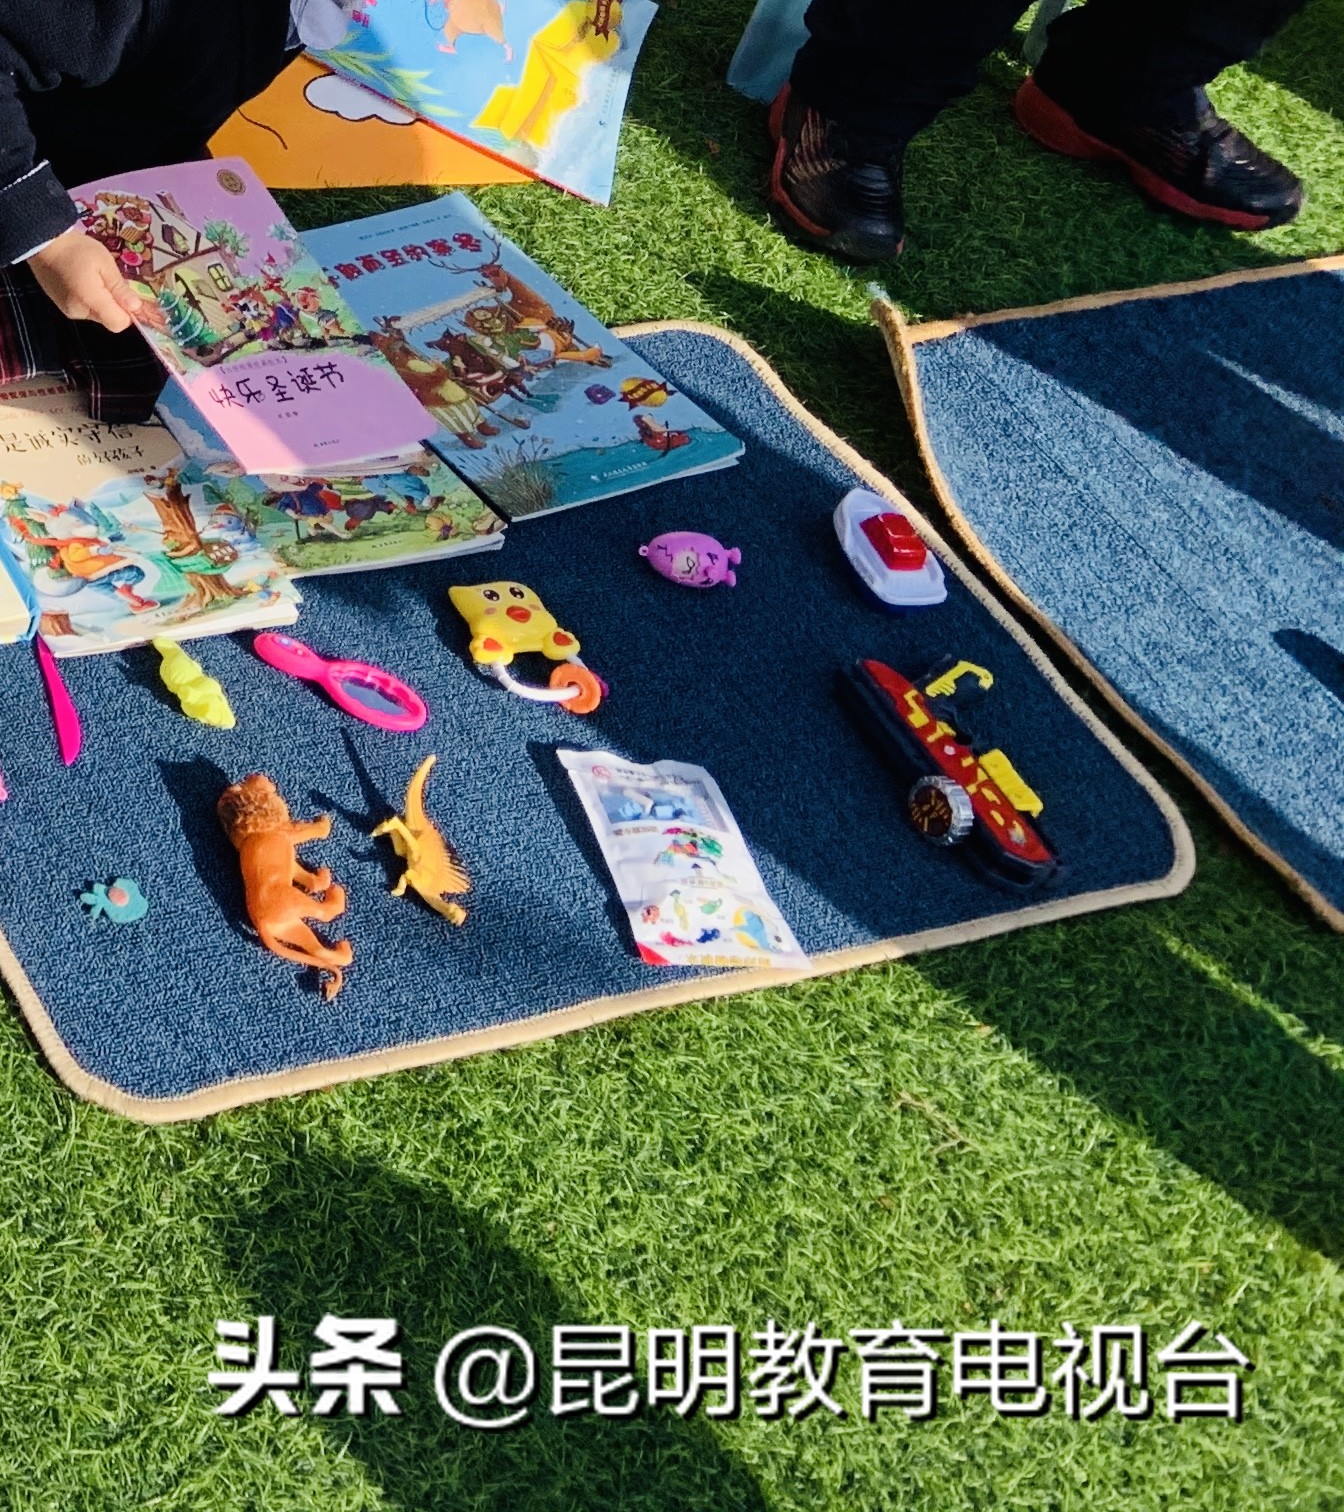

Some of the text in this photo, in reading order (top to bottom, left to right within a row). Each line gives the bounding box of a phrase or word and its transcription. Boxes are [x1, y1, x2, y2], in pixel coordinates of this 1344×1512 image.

[208, 361, 345, 408] 快乐圣诞节
[76, 445, 144, 466] 的好孩子
